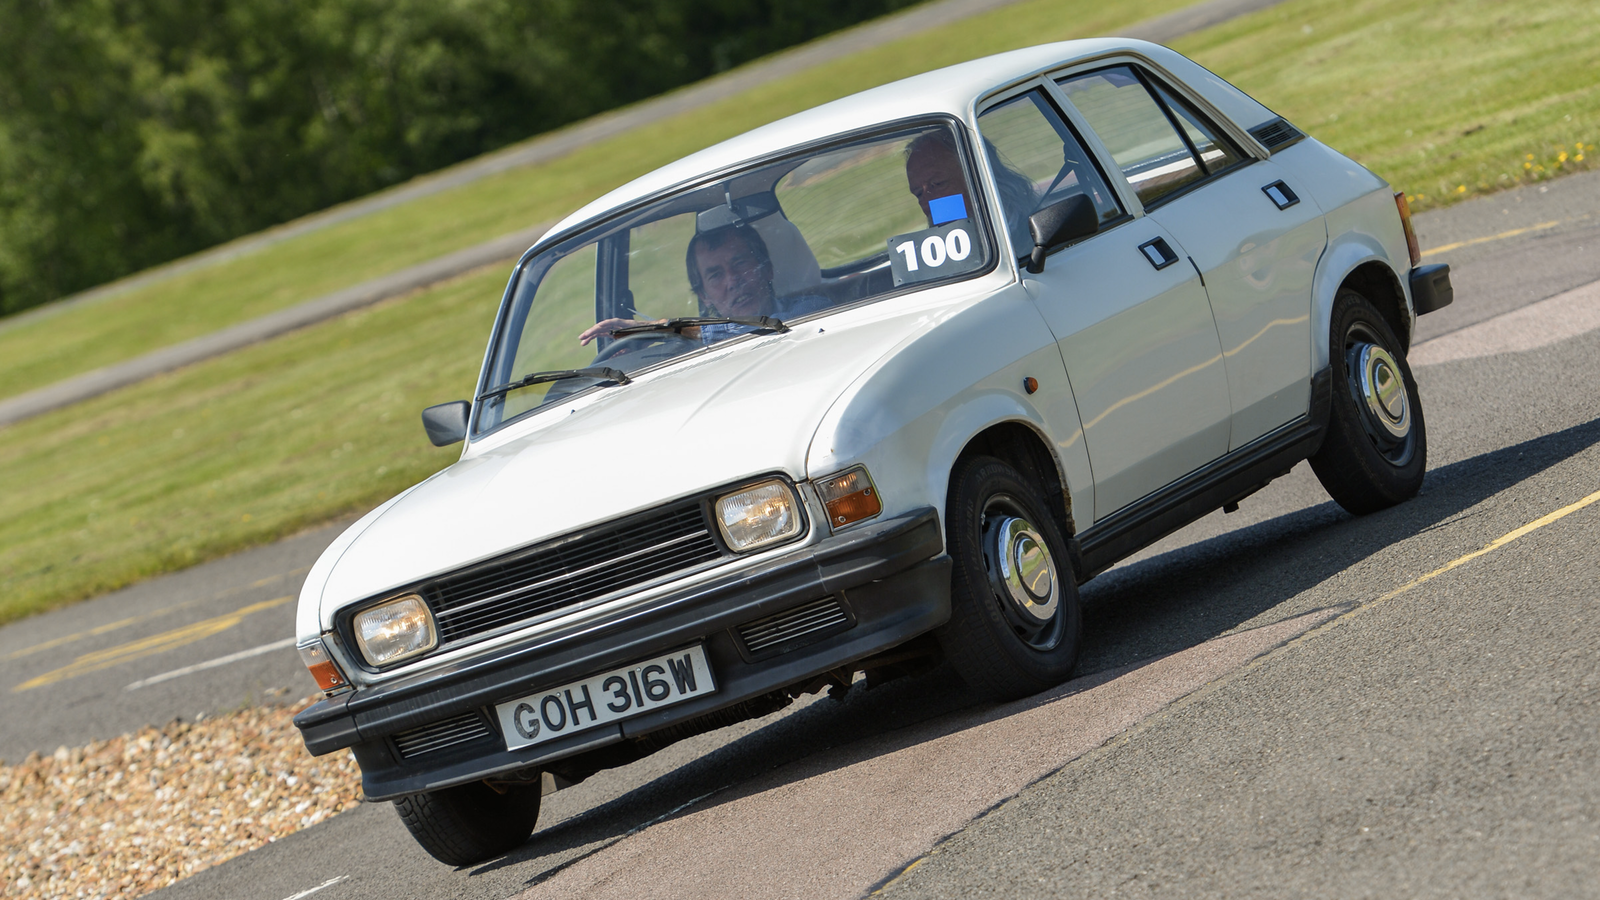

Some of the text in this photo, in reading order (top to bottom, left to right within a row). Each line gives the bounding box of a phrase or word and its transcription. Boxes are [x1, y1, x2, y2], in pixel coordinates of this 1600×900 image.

[896, 228, 971, 272] 100
[513, 653, 698, 740] GOH 316W
